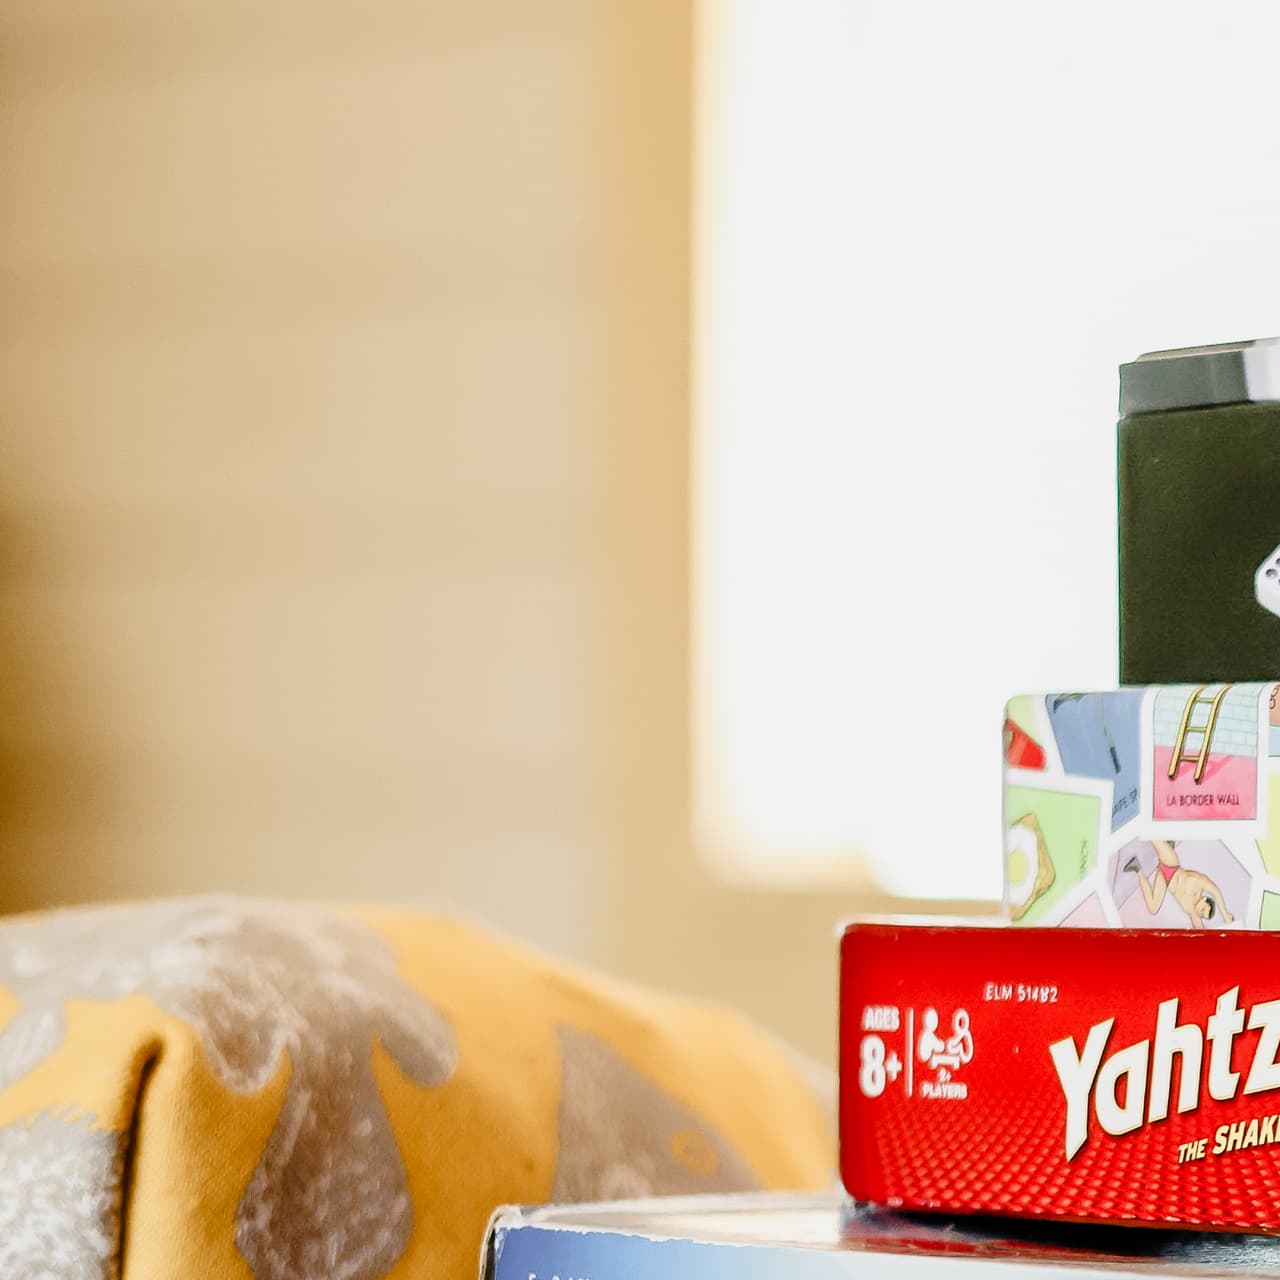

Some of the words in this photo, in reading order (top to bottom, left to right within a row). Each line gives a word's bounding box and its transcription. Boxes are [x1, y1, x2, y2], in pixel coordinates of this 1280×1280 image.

[1179, 794, 1214, 806] BORDER
[1217, 794, 1240, 806] WALL
[862, 1005, 900, 1031] AGES
[859, 1035, 902, 1098] 8+
[1178, 1138, 1208, 1164] THE
